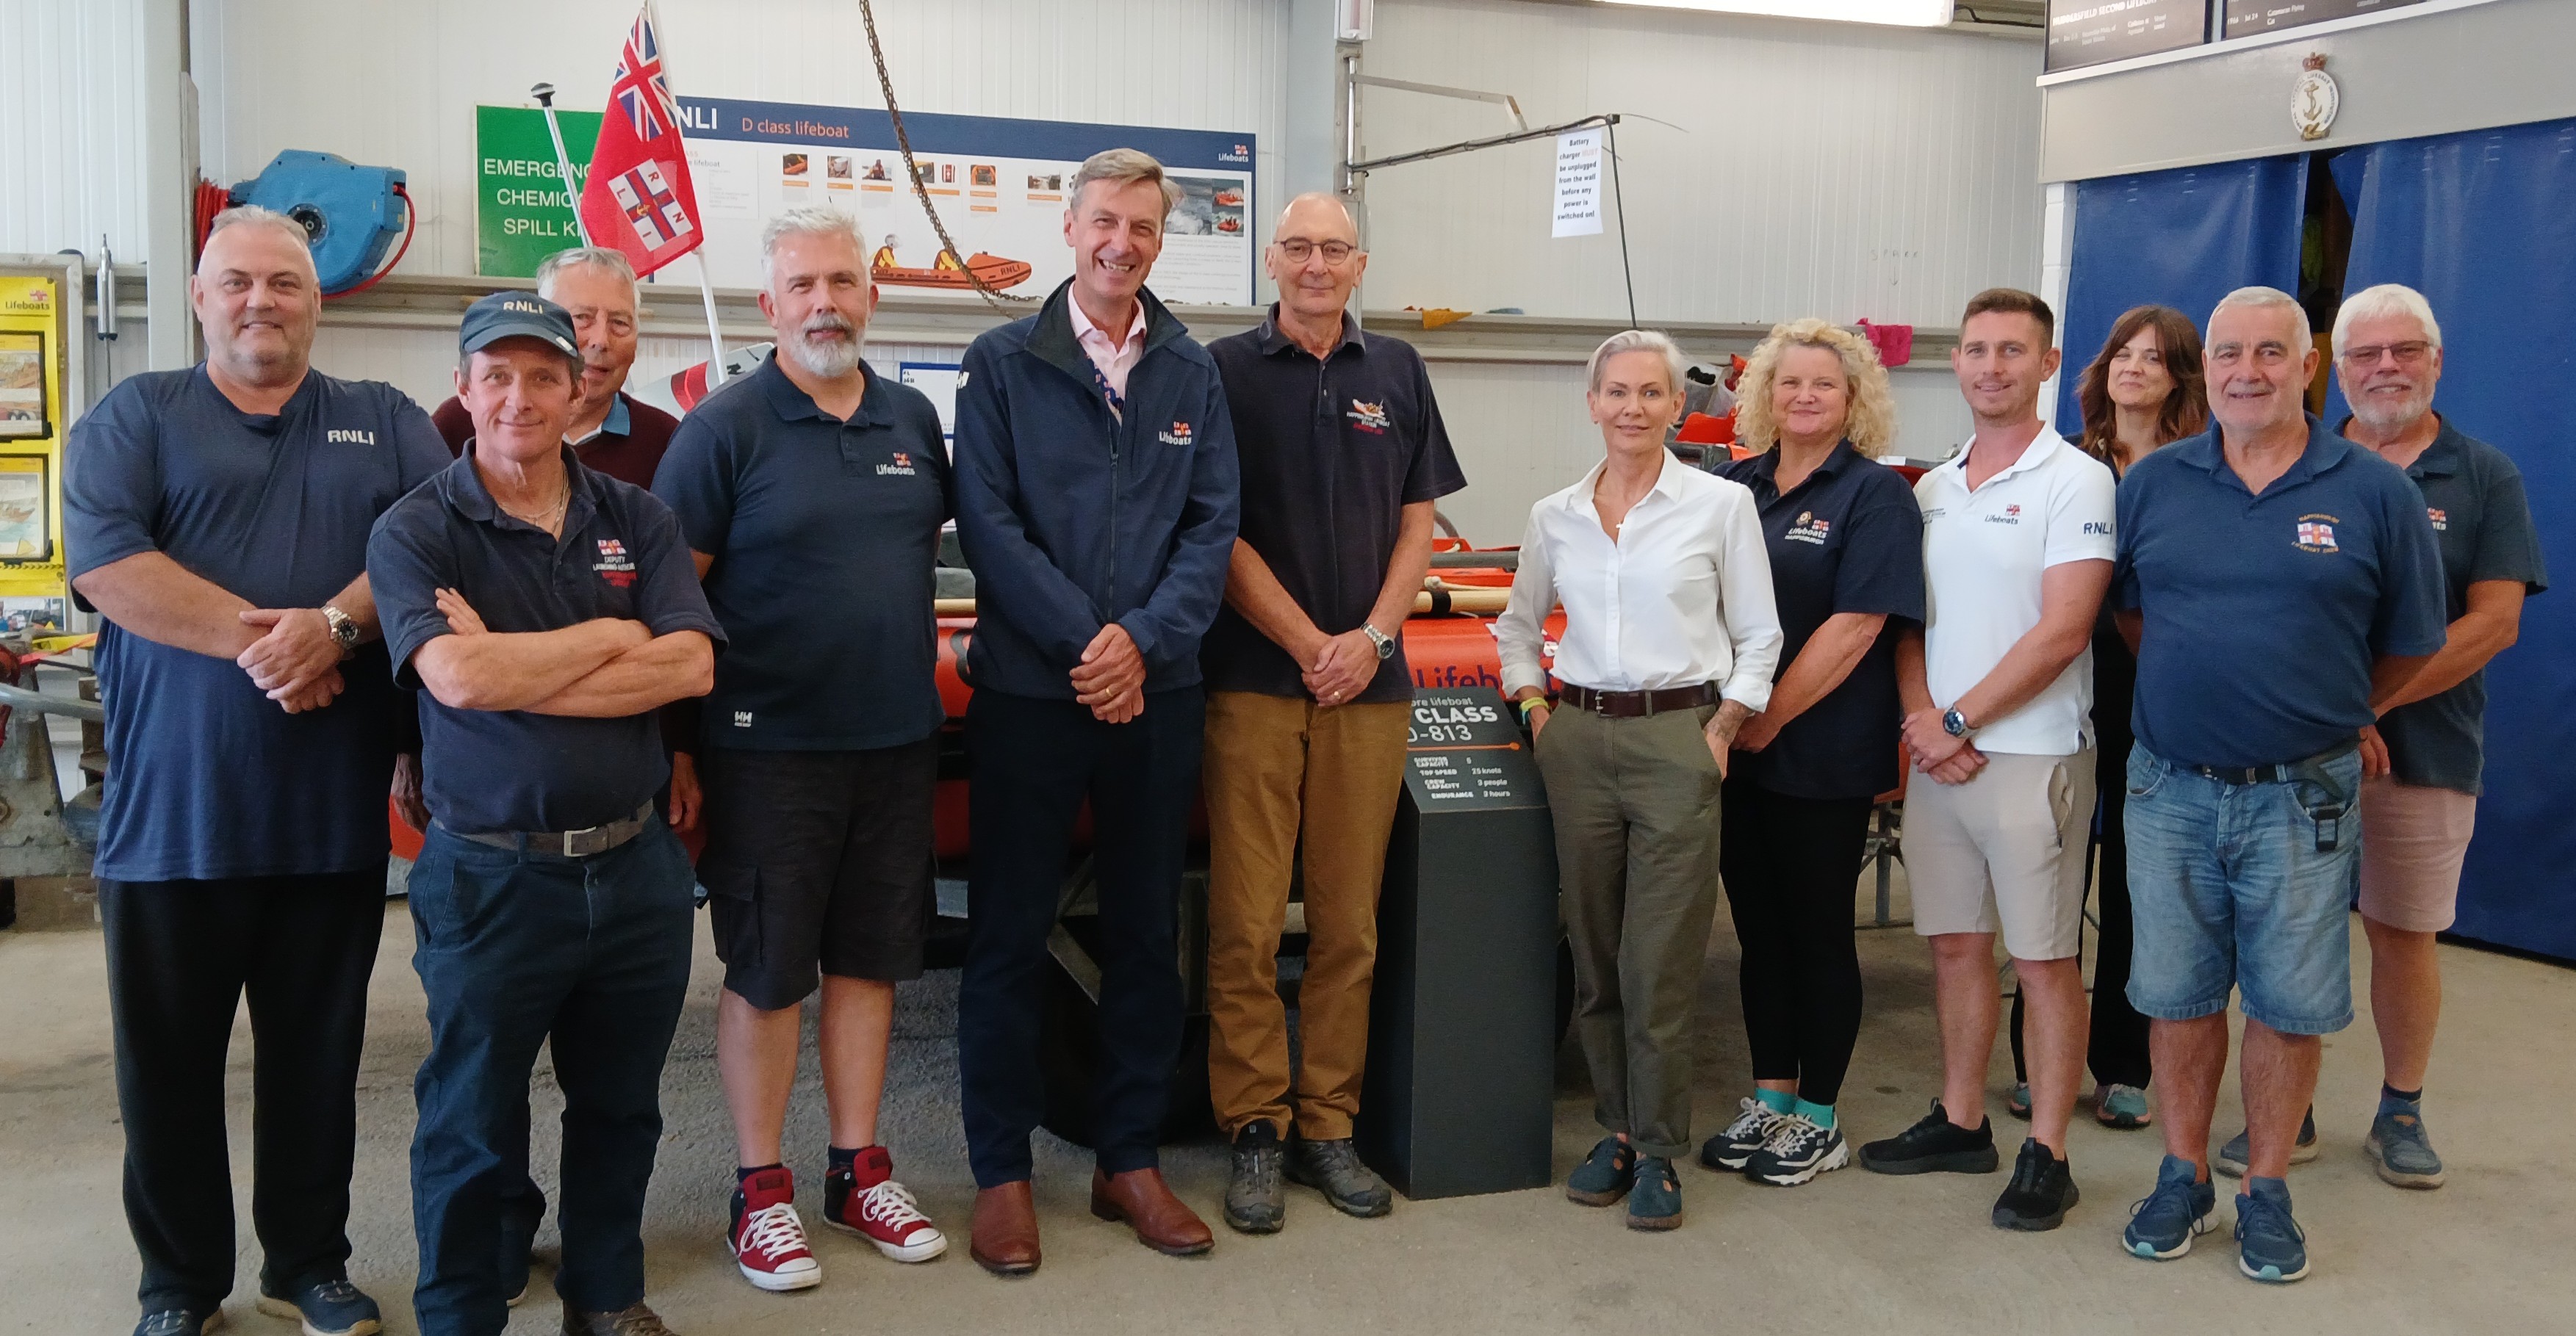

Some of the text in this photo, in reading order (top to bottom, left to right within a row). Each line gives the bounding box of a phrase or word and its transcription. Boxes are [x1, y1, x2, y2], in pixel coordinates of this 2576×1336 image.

[677, 106, 717, 130] NLI
[742, 117, 849, 138] D class lifeboat
[1569, 138, 1589, 146] Battery
[1218, 153, 1249, 162] Lifeboats
[1559, 151, 1580, 160] charger
[484, 158, 591, 179] EMERGENC
[1568, 161, 1597, 171] unplugged
[616, 187, 626, 200] L
[648, 171, 685, 223] R N
[1564, 201, 1581, 209] power
[1558, 212, 1583, 220] switched
[504, 217, 582, 237] SPILL KI
[5, 300, 50, 311] Lifeboats
[503, 300, 543, 314] RNLI
[328, 430, 375, 446] RNLI
[1159, 430, 1192, 446] Lifeboats
[876, 463, 915, 476] Lifeboats
[1985, 514, 2018, 525] Lifeboats
[1788, 527, 1827, 539] Lifeboats
[2083, 521, 2113, 535] RNLI
[1430, 697, 1473, 706] lifeboat
[1414, 706, 1498, 724] CLASS
[1477, 779, 1483, 787] 3
[1483, 779, 1508, 787] people
[1431, 791, 1474, 799] ENDURANCE
